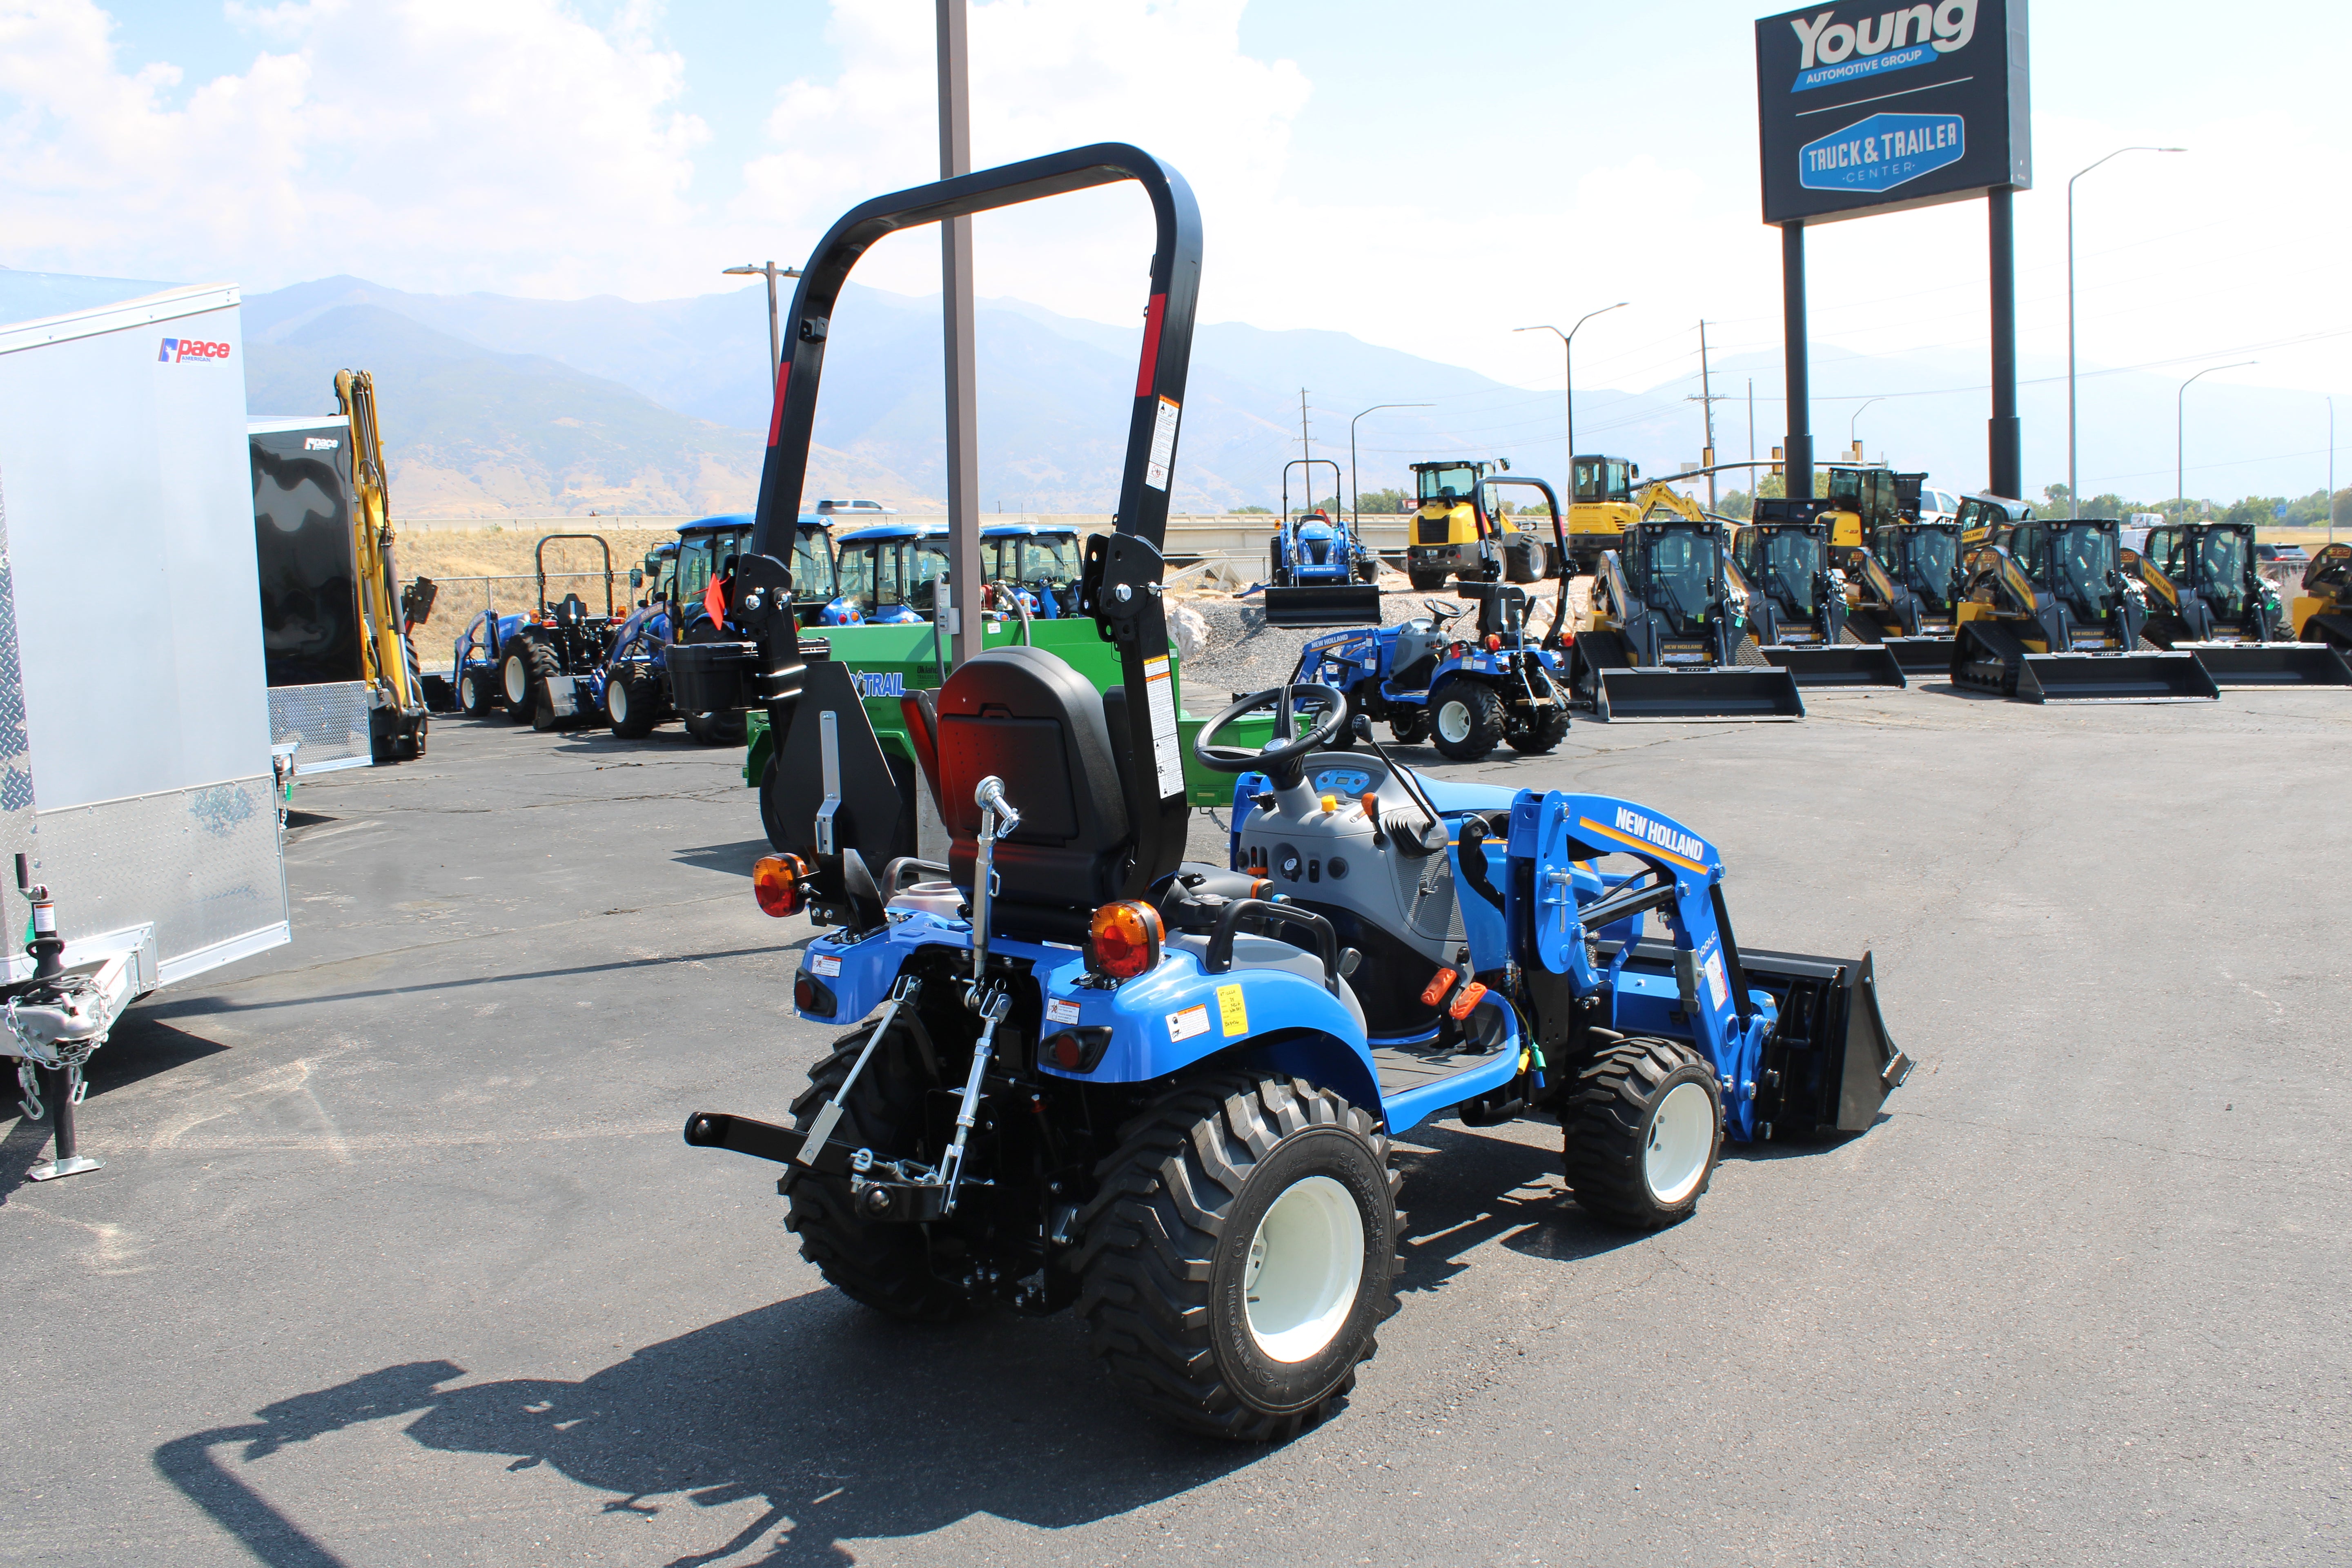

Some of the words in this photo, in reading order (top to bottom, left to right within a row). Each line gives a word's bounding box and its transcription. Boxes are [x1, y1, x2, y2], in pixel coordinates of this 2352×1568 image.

[1791, 0, 1978, 69] Young
[1806, 59, 1878, 84] AUTOMOTIVE
[1881, 49, 1922, 67] GROUP
[1808, 141, 1862, 172] TRUCK
[1864, 137, 1879, 164] &
[1880, 123, 1956, 160] TRAILER
[1846, 163, 1912, 183] CENTER
[176, 339, 230, 363] pace
[313, 437, 339, 450] pace
[1311, 640, 1324, 648] NEW
[1324, 634, 1348, 645] HOLLAND
[917, 665, 948, 673] Oklahoa
[863, 672, 906, 697] TRAIL
[1615, 806, 1647, 838] NEW
[1647, 820, 1704, 862] HOLLAND
[1698, 930, 1717, 958] 100LC
